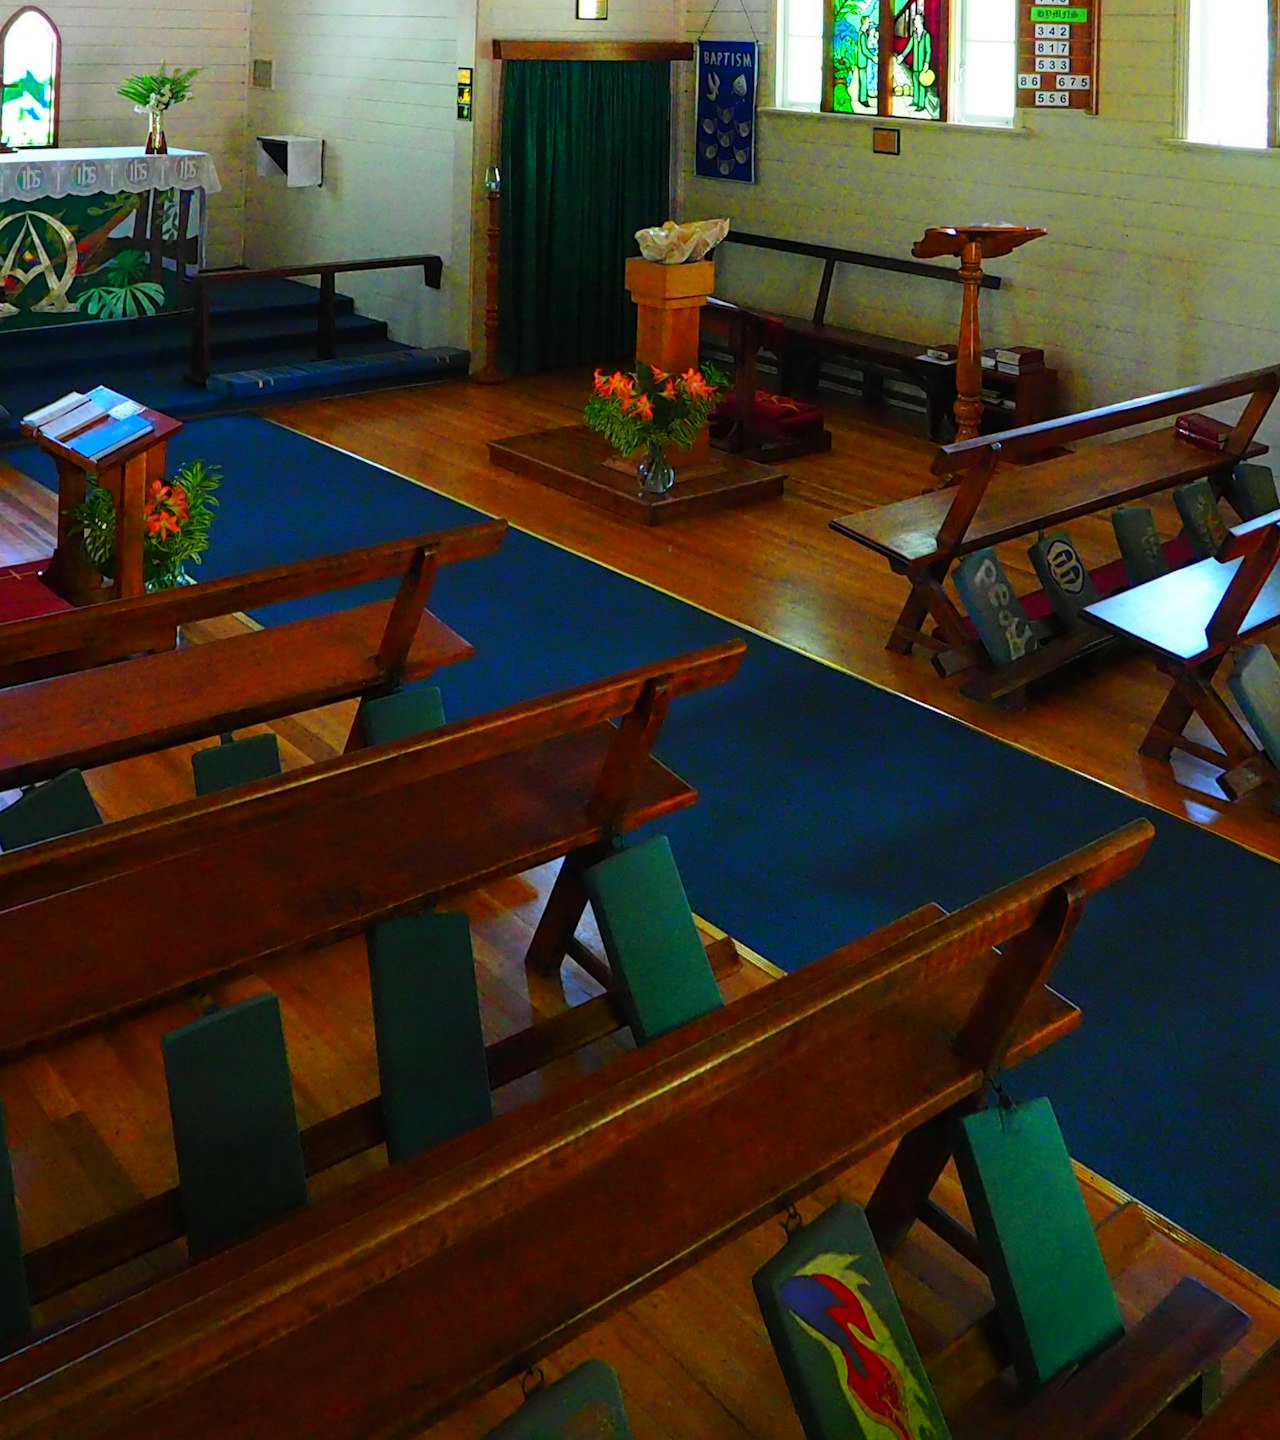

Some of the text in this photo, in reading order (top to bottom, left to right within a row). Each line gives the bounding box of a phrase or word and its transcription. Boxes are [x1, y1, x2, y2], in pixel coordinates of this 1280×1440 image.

[1037, 26, 1067, 37] 342
[1037, 43, 1067, 54] 817
[703, 51, 752, 68] BAPTISM
[1038, 60, 1067, 71] 533
[1020, 77, 1088, 88] 86 675
[1037, 93, 1067, 105] 556
